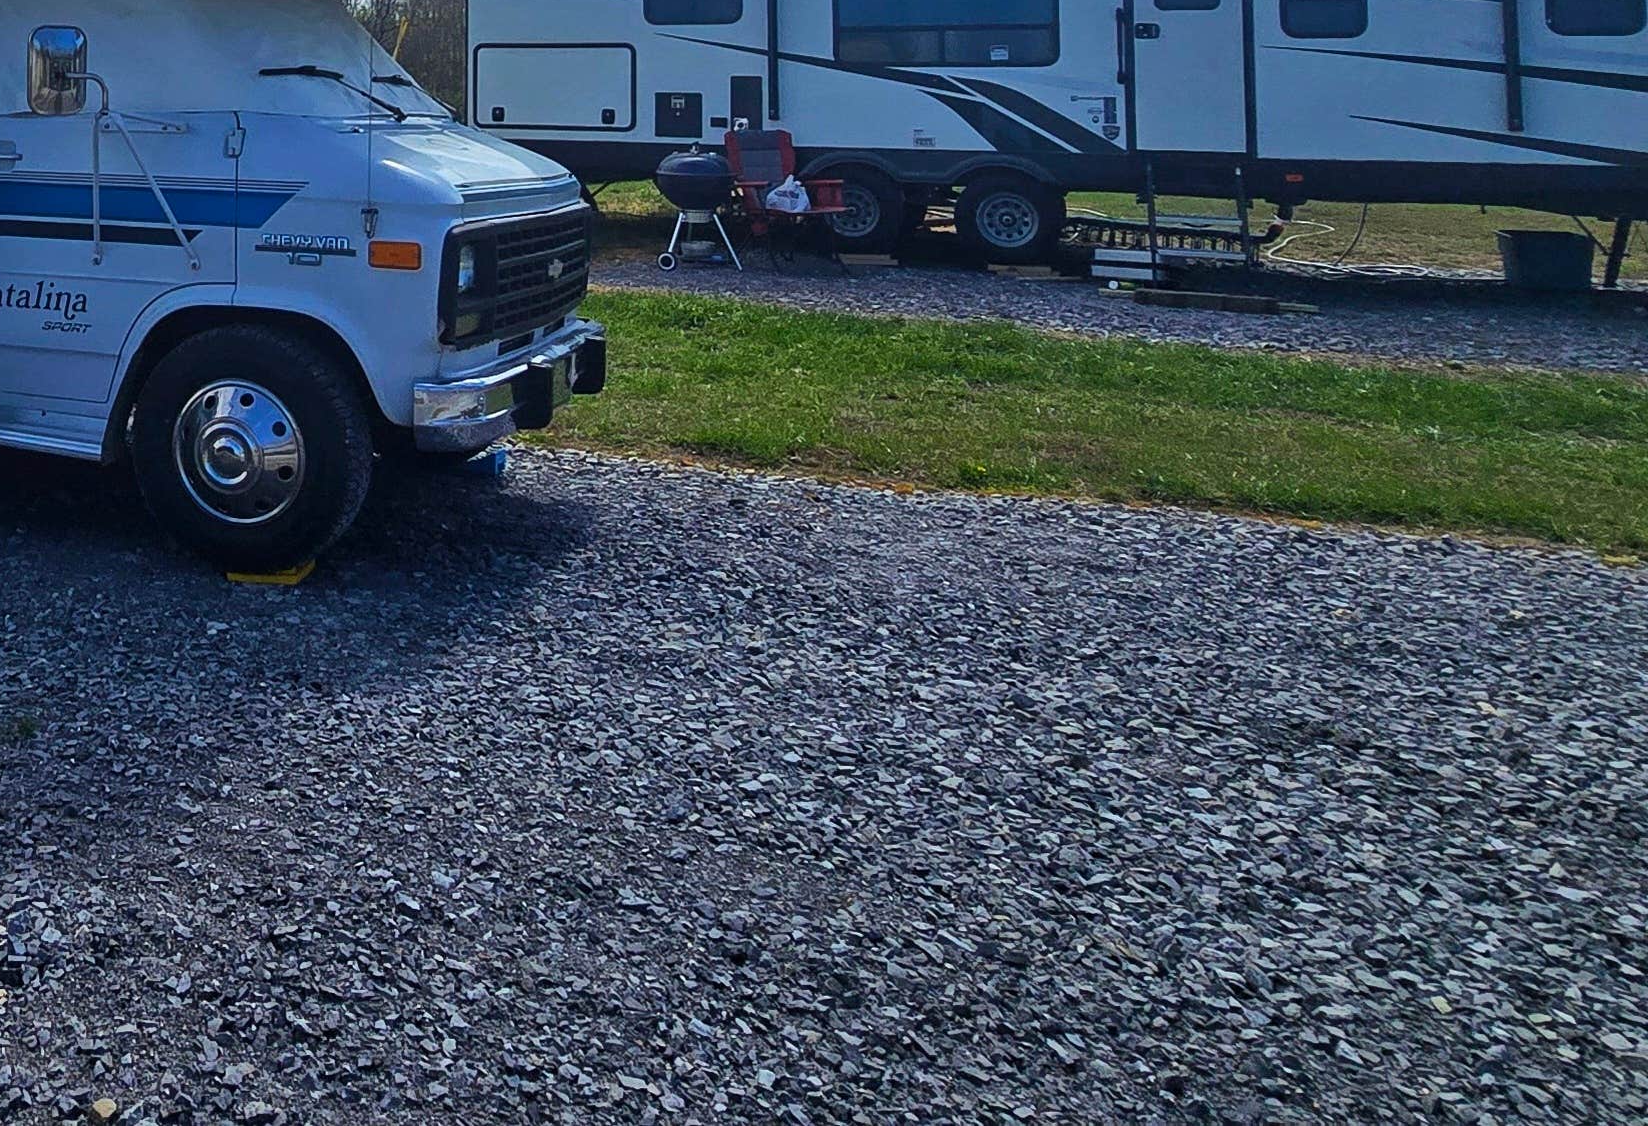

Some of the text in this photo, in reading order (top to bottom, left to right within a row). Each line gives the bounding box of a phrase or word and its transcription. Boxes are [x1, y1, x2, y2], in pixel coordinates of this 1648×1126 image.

[261, 234, 349, 251] CHEVY VAN
[41, 320, 92, 334] SPORT
